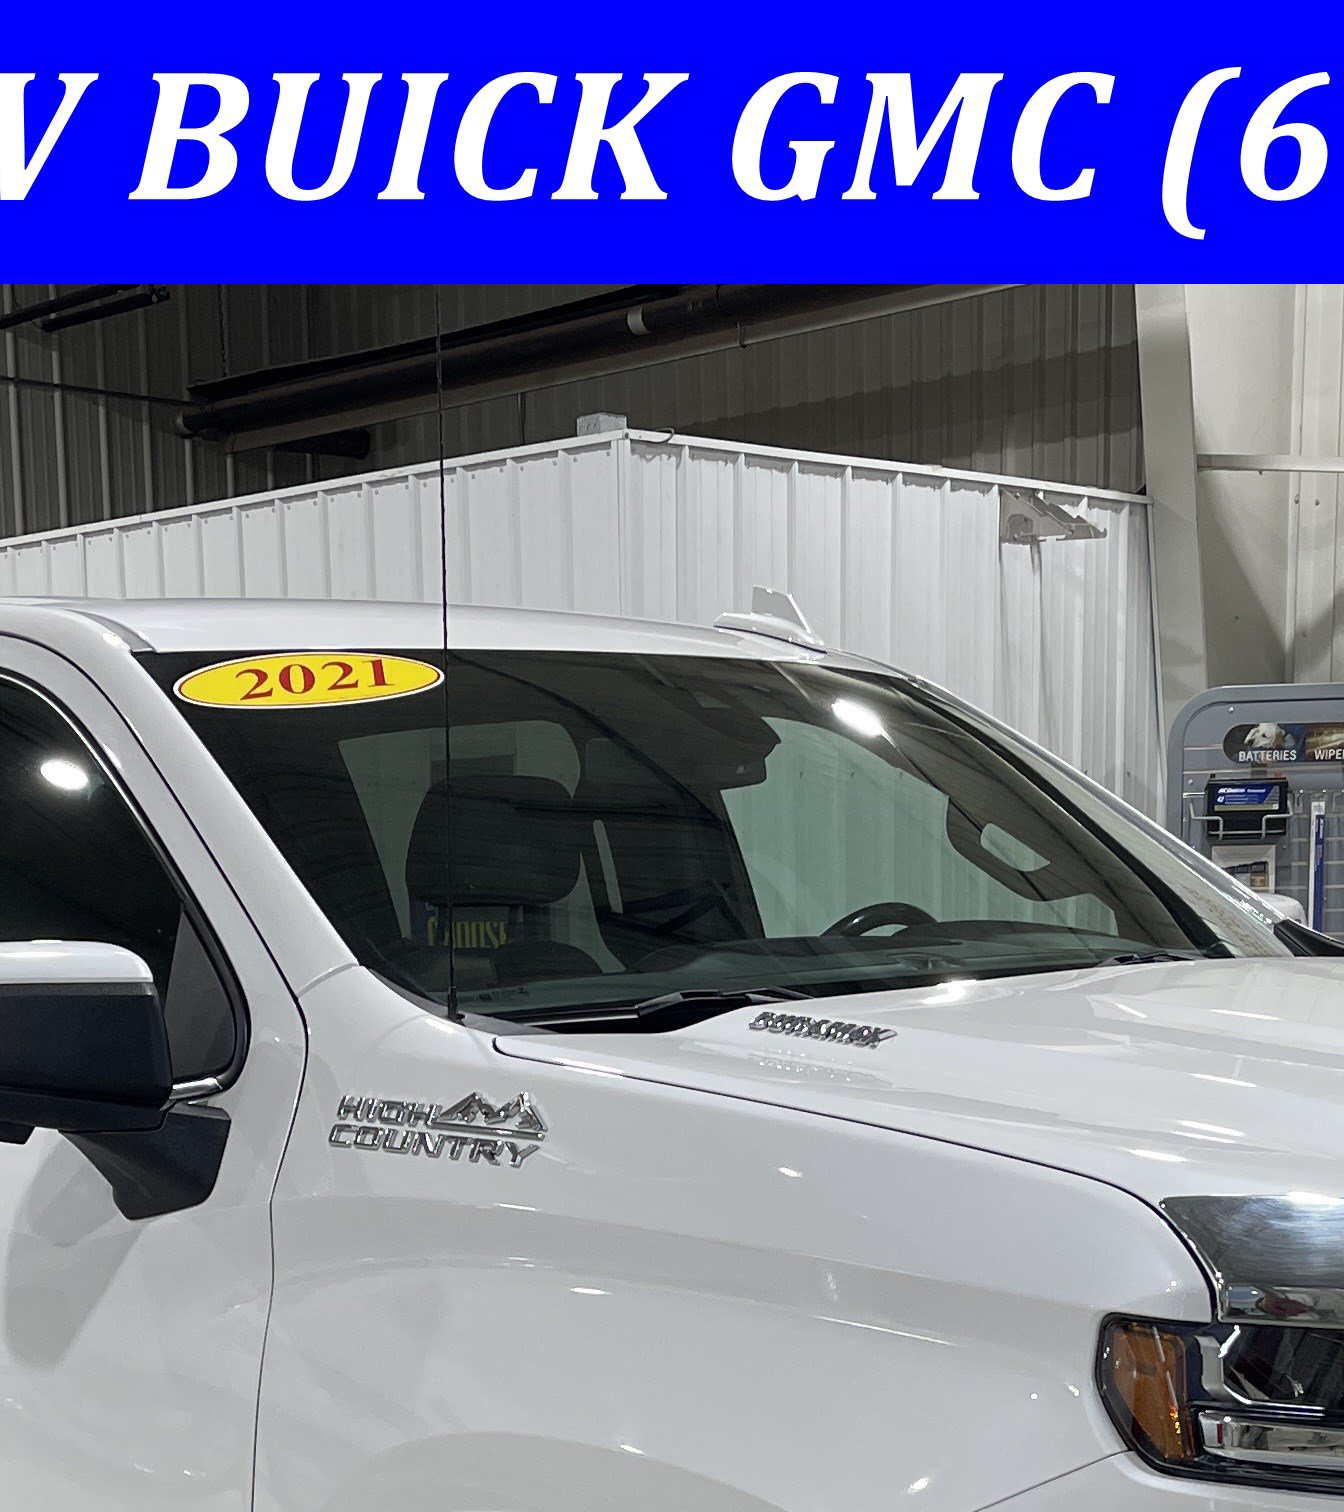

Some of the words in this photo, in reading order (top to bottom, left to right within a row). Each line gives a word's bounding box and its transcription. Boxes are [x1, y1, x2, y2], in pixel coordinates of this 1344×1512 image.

[235, 659, 395, 700] 2021
[1238, 749, 1297, 762] BATTERIES
[337, 1094, 444, 1126] HIGH
[328, 1123, 540, 1168] COUNTRY
